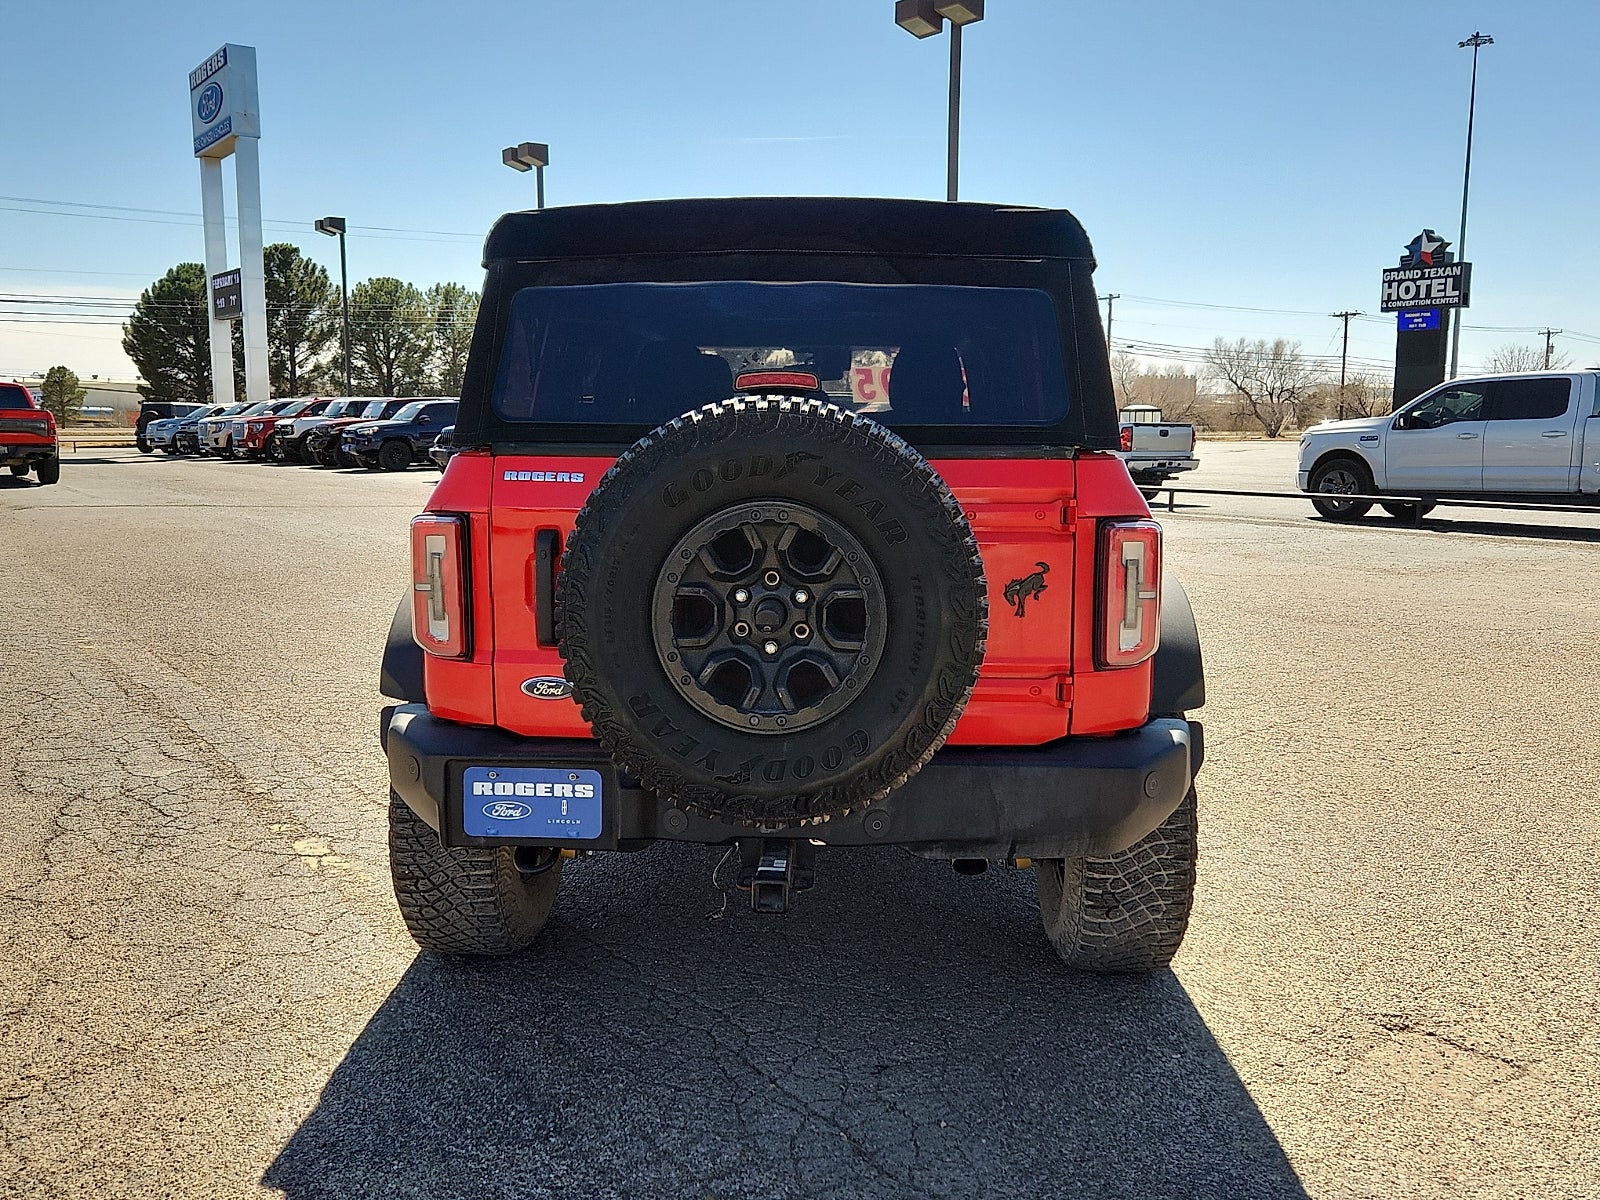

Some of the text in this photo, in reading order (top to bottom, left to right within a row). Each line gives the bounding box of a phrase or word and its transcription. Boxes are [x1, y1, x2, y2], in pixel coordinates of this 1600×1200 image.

[190, 49, 225, 90] ROGERS
[202, 89, 216, 117] Ford
[1383, 266, 1462, 281] GRAND TEXAN
[1382, 277, 1460, 301] HOTEL
[1387, 298, 1431, 308] CONVENTION
[1432, 296, 1459, 305] CENTER
[503, 470, 585, 483] ROGERS
[533, 681, 565, 696] Ford
[472, 781, 594, 798] ROGERS
[491, 803, 523, 818] Ford
